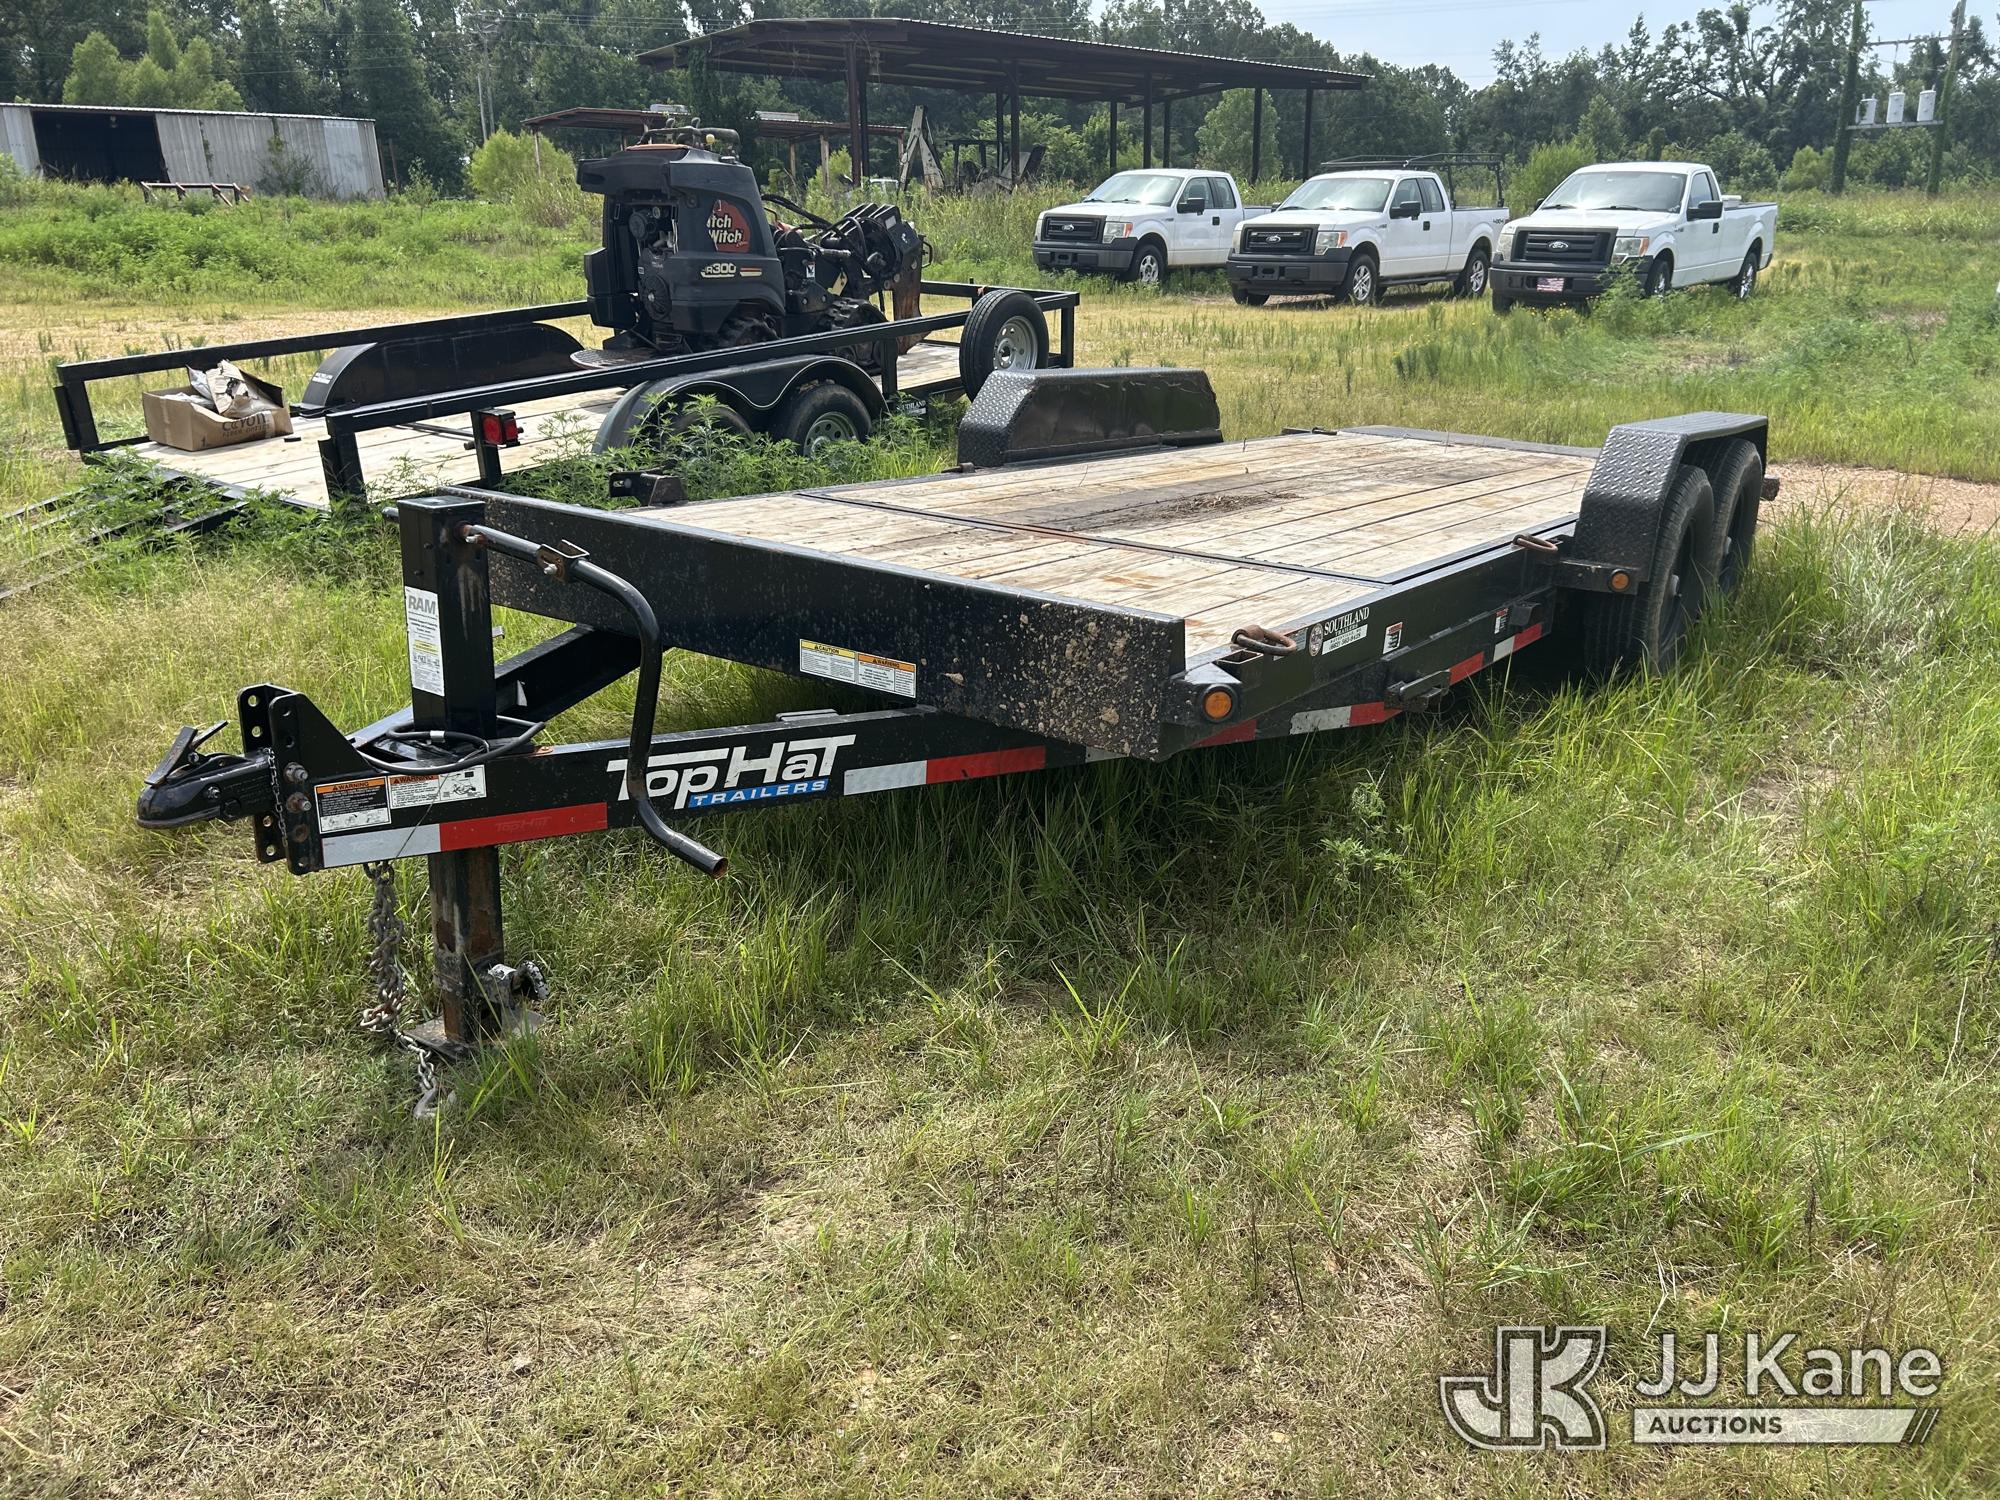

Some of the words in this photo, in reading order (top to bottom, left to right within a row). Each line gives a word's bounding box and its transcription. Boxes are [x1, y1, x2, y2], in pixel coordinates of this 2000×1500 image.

[408, 595, 436, 615] RAM
[1324, 607, 1369, 635] SOUTHLAND
[339, 781, 369, 790] WARNING
[693, 780, 826, 806] TRAILERS
